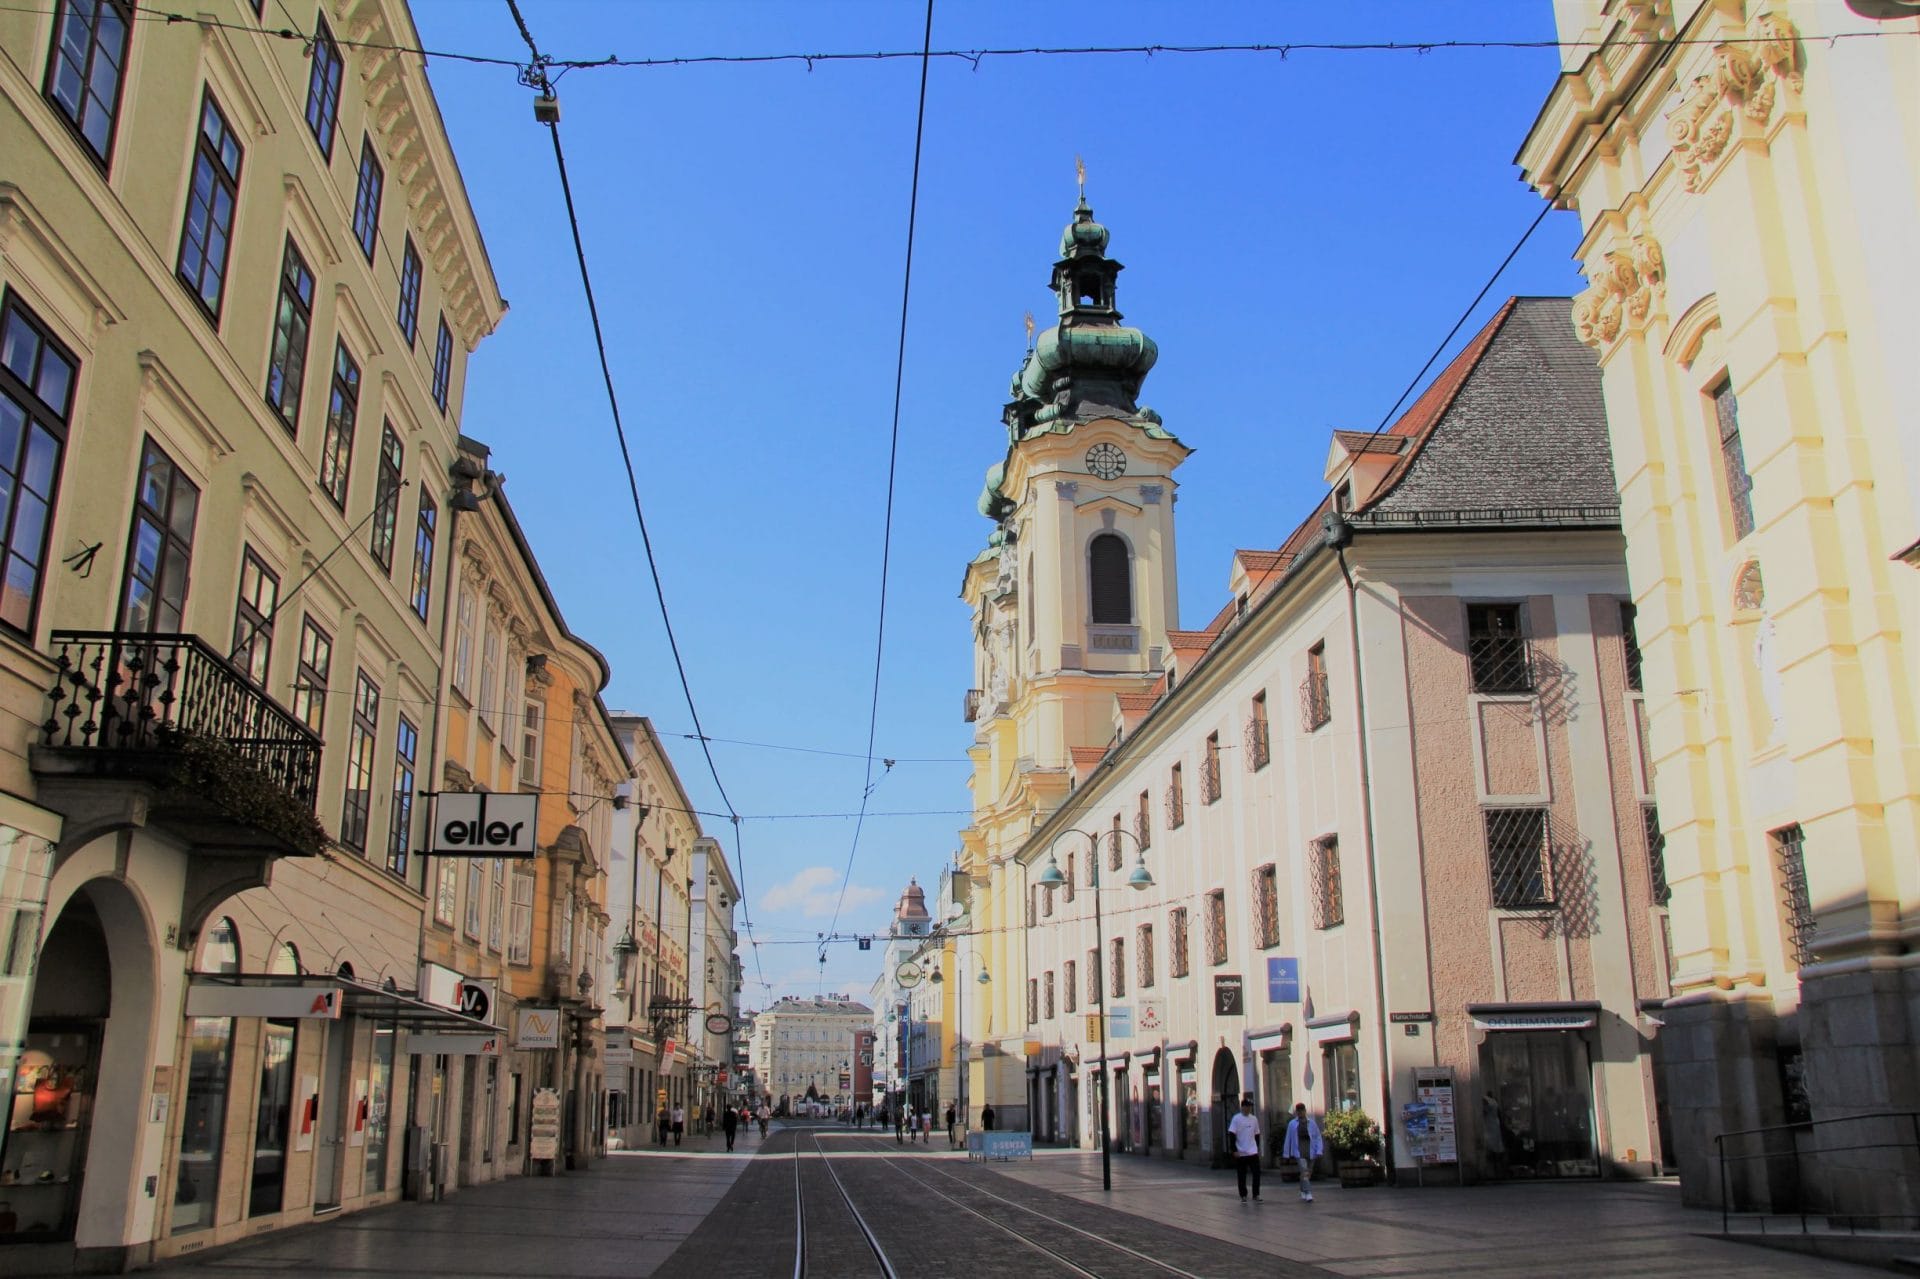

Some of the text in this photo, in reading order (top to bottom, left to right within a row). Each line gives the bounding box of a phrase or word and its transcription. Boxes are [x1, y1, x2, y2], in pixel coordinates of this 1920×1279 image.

[444, 804, 524, 846] eiler
[310, 992, 333, 1015] A1
[1509, 1015, 1588, 1027] HEIMATWERK
[483, 1039, 495, 1052] A1
